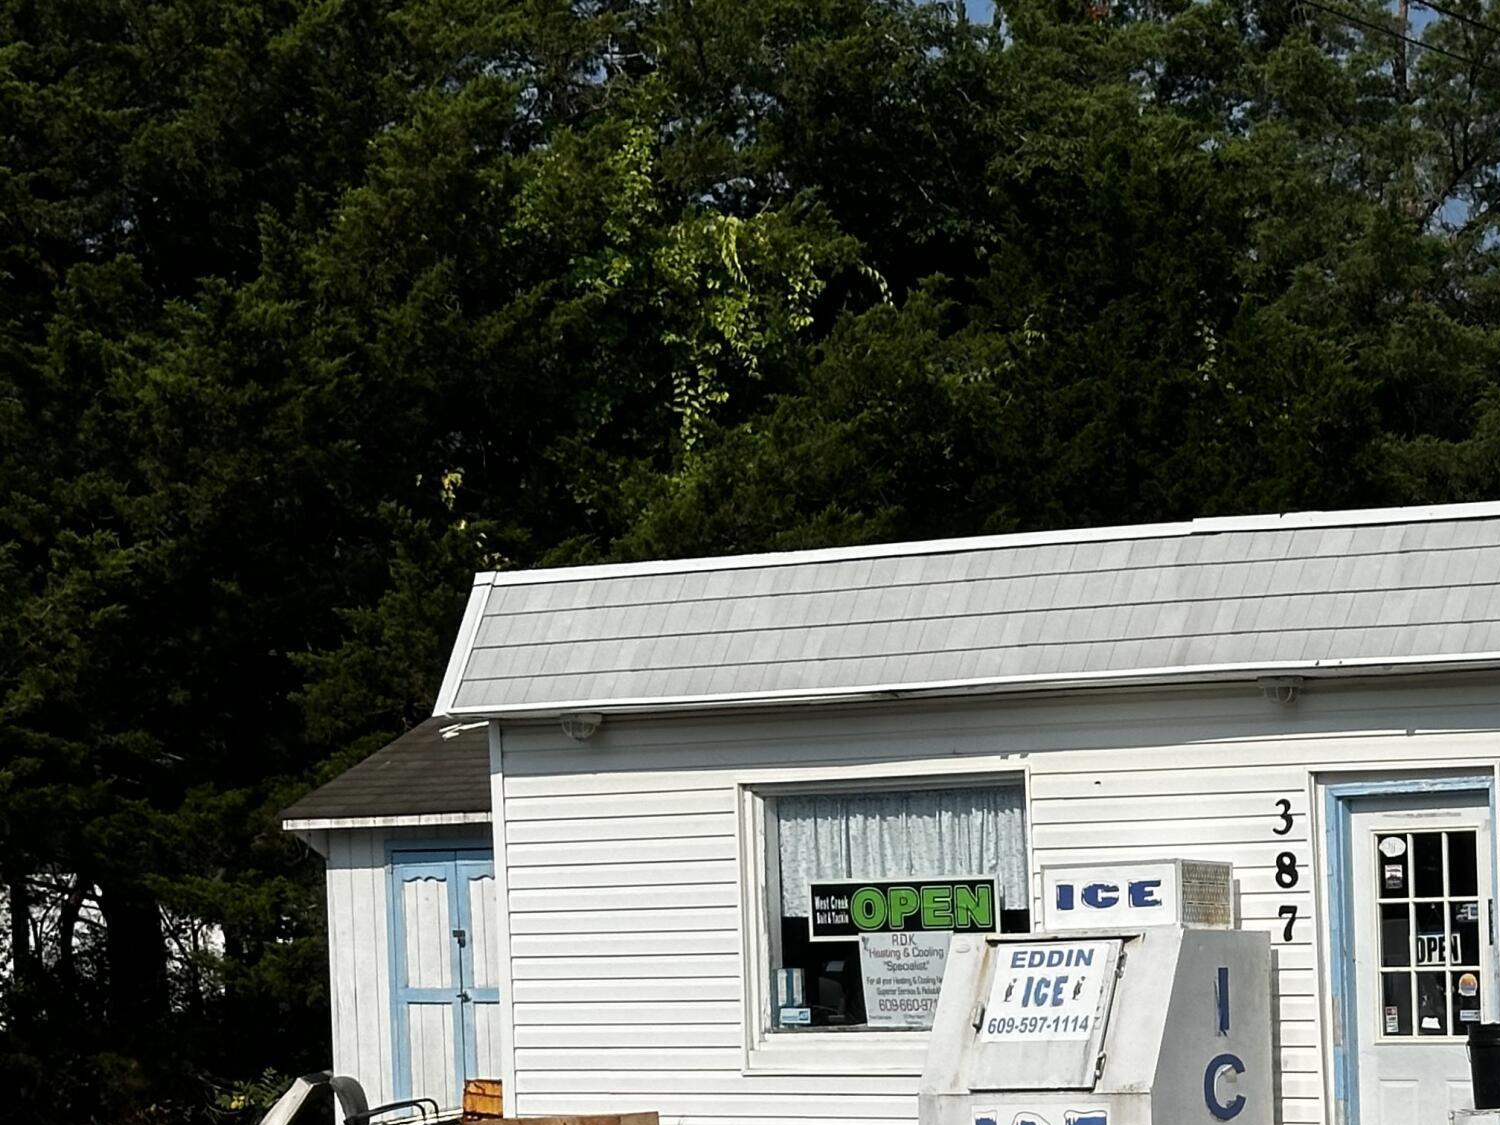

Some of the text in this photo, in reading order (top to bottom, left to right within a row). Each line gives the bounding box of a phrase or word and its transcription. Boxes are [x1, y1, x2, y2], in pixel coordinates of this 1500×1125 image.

[851, 884, 992, 930] OPEN
[1055, 879, 1162, 911] ICE
[903, 947, 910, 958] &
[912, 947, 944, 959] Cooling
[1010, 948, 1094, 969] EDDIN
[1416, 934, 1459, 964] OPEN
[1021, 975, 1069, 1008] ICE
[988, 1015, 1089, 1034] 609-597-1114
